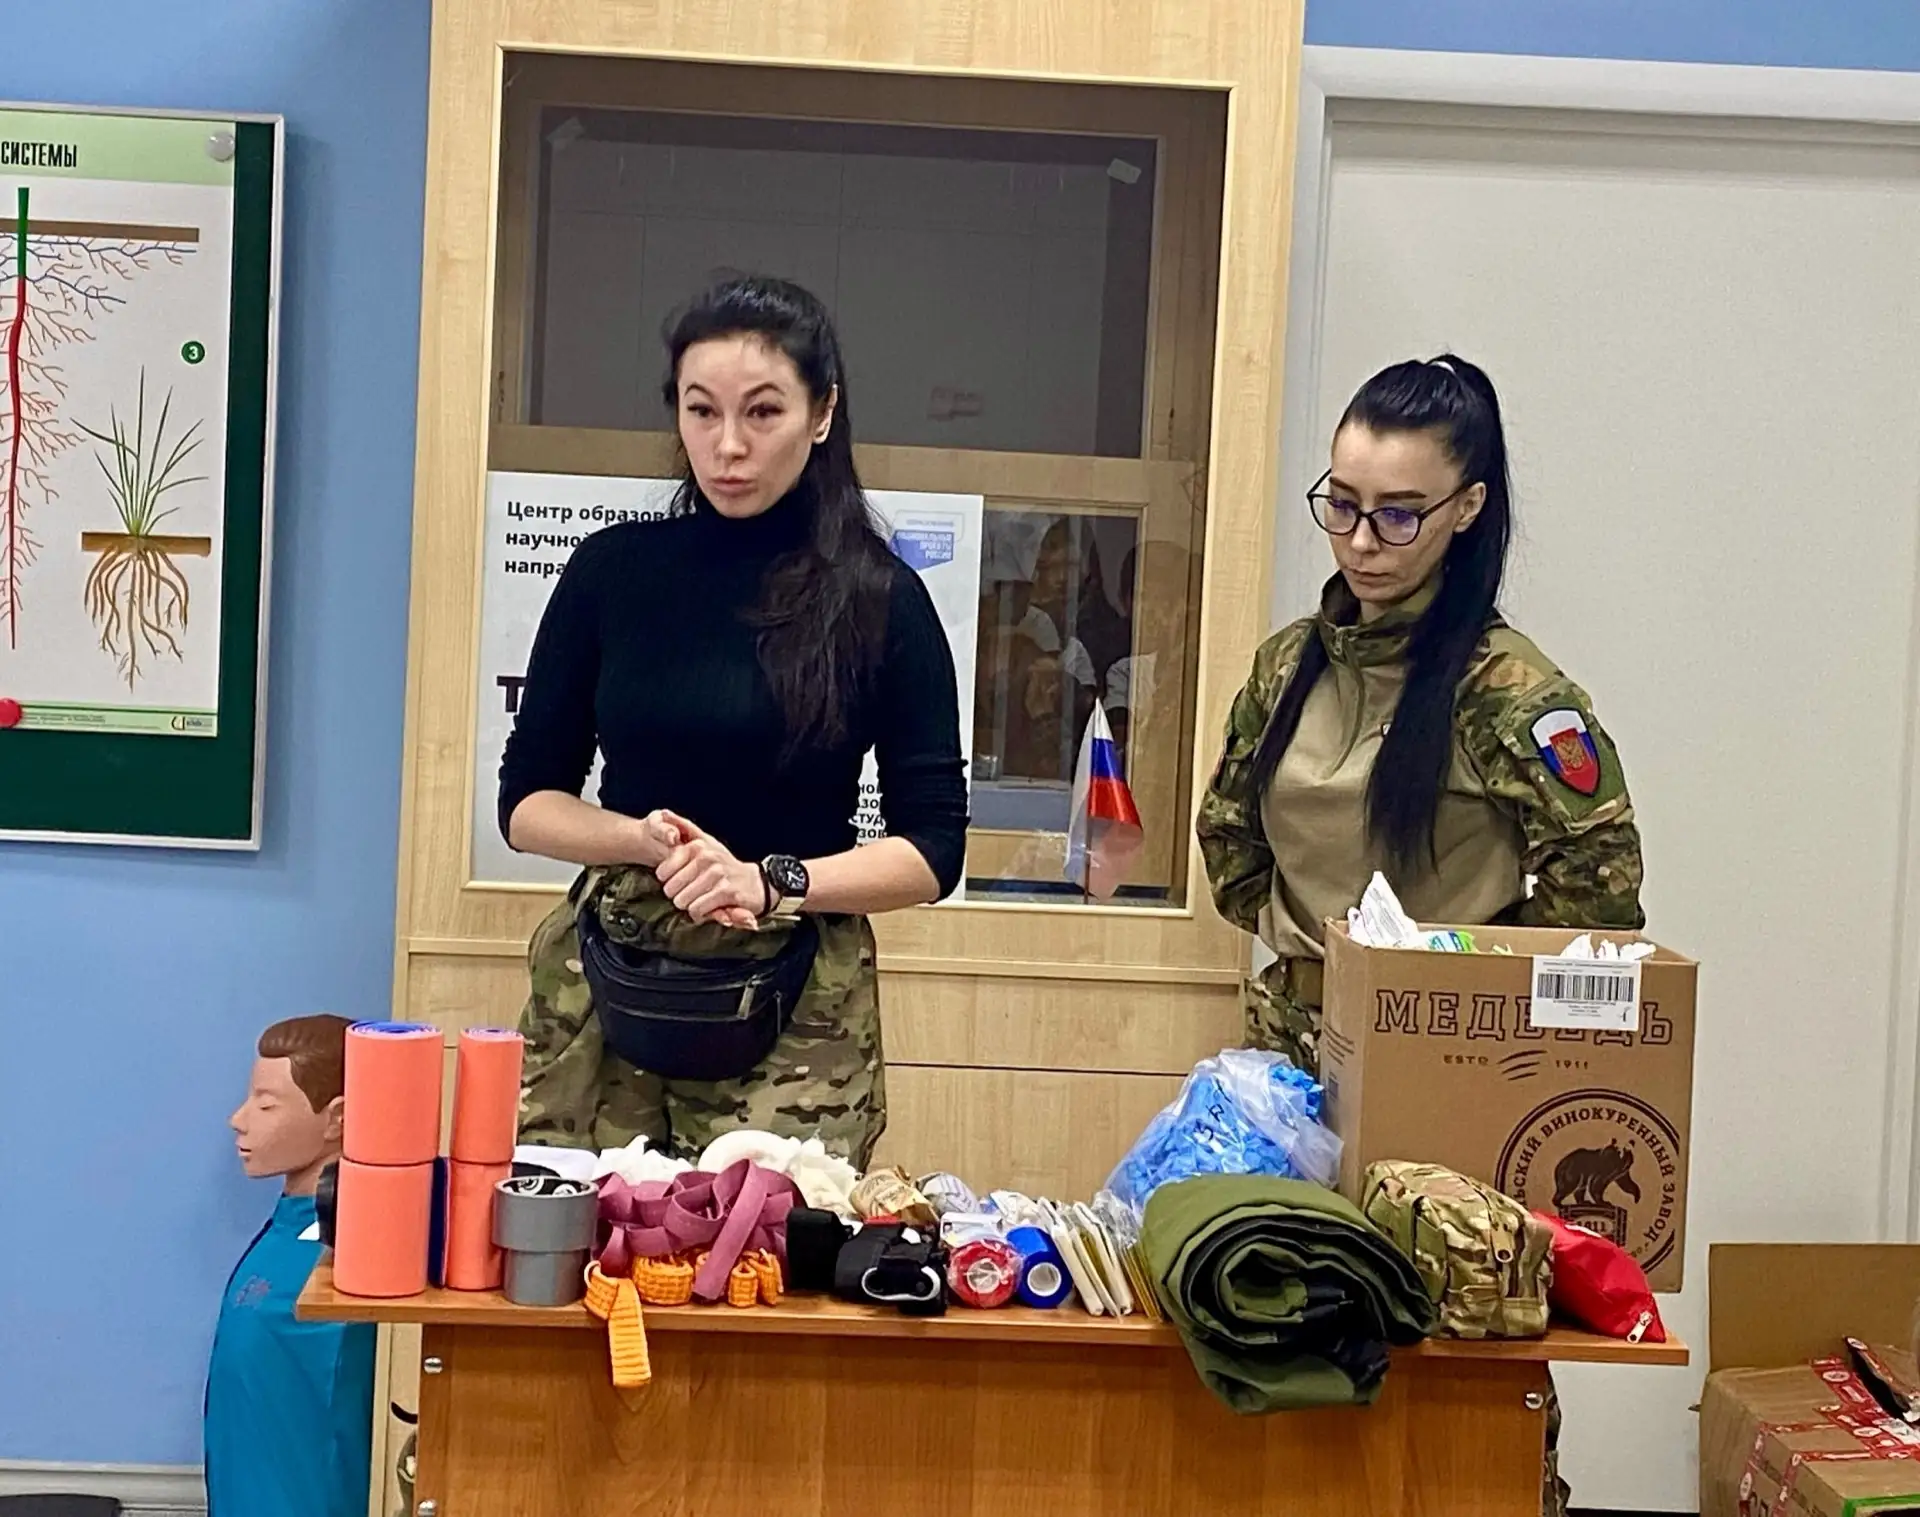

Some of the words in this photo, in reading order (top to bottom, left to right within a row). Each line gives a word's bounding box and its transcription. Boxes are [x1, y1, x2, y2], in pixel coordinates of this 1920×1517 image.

[1, 141, 77, 167] СИСТЕМЫ
[507, 501, 573, 524] Центр
[1540, 1107, 1676, 1177] ВИНОКУРЕННЫЙ
